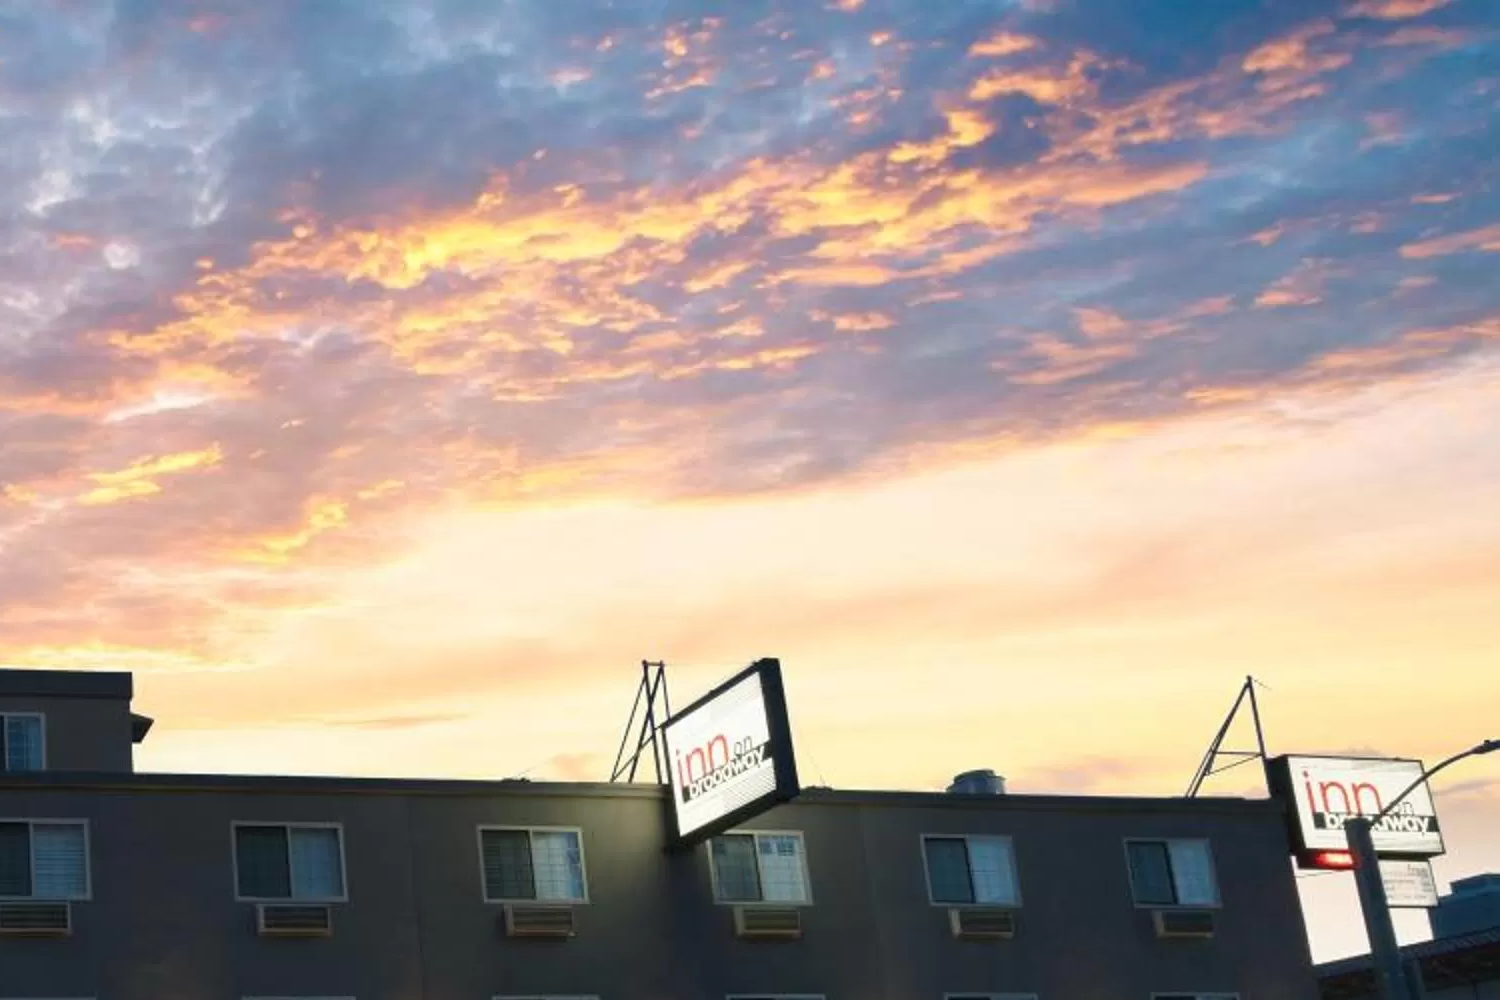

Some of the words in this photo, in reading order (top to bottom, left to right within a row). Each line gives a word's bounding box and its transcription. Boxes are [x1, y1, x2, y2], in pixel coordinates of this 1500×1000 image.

[675, 734, 730, 789] inn
[733, 735, 752, 756] on
[689, 746, 765, 798] broadway
[1303, 770, 1381, 815] inn
